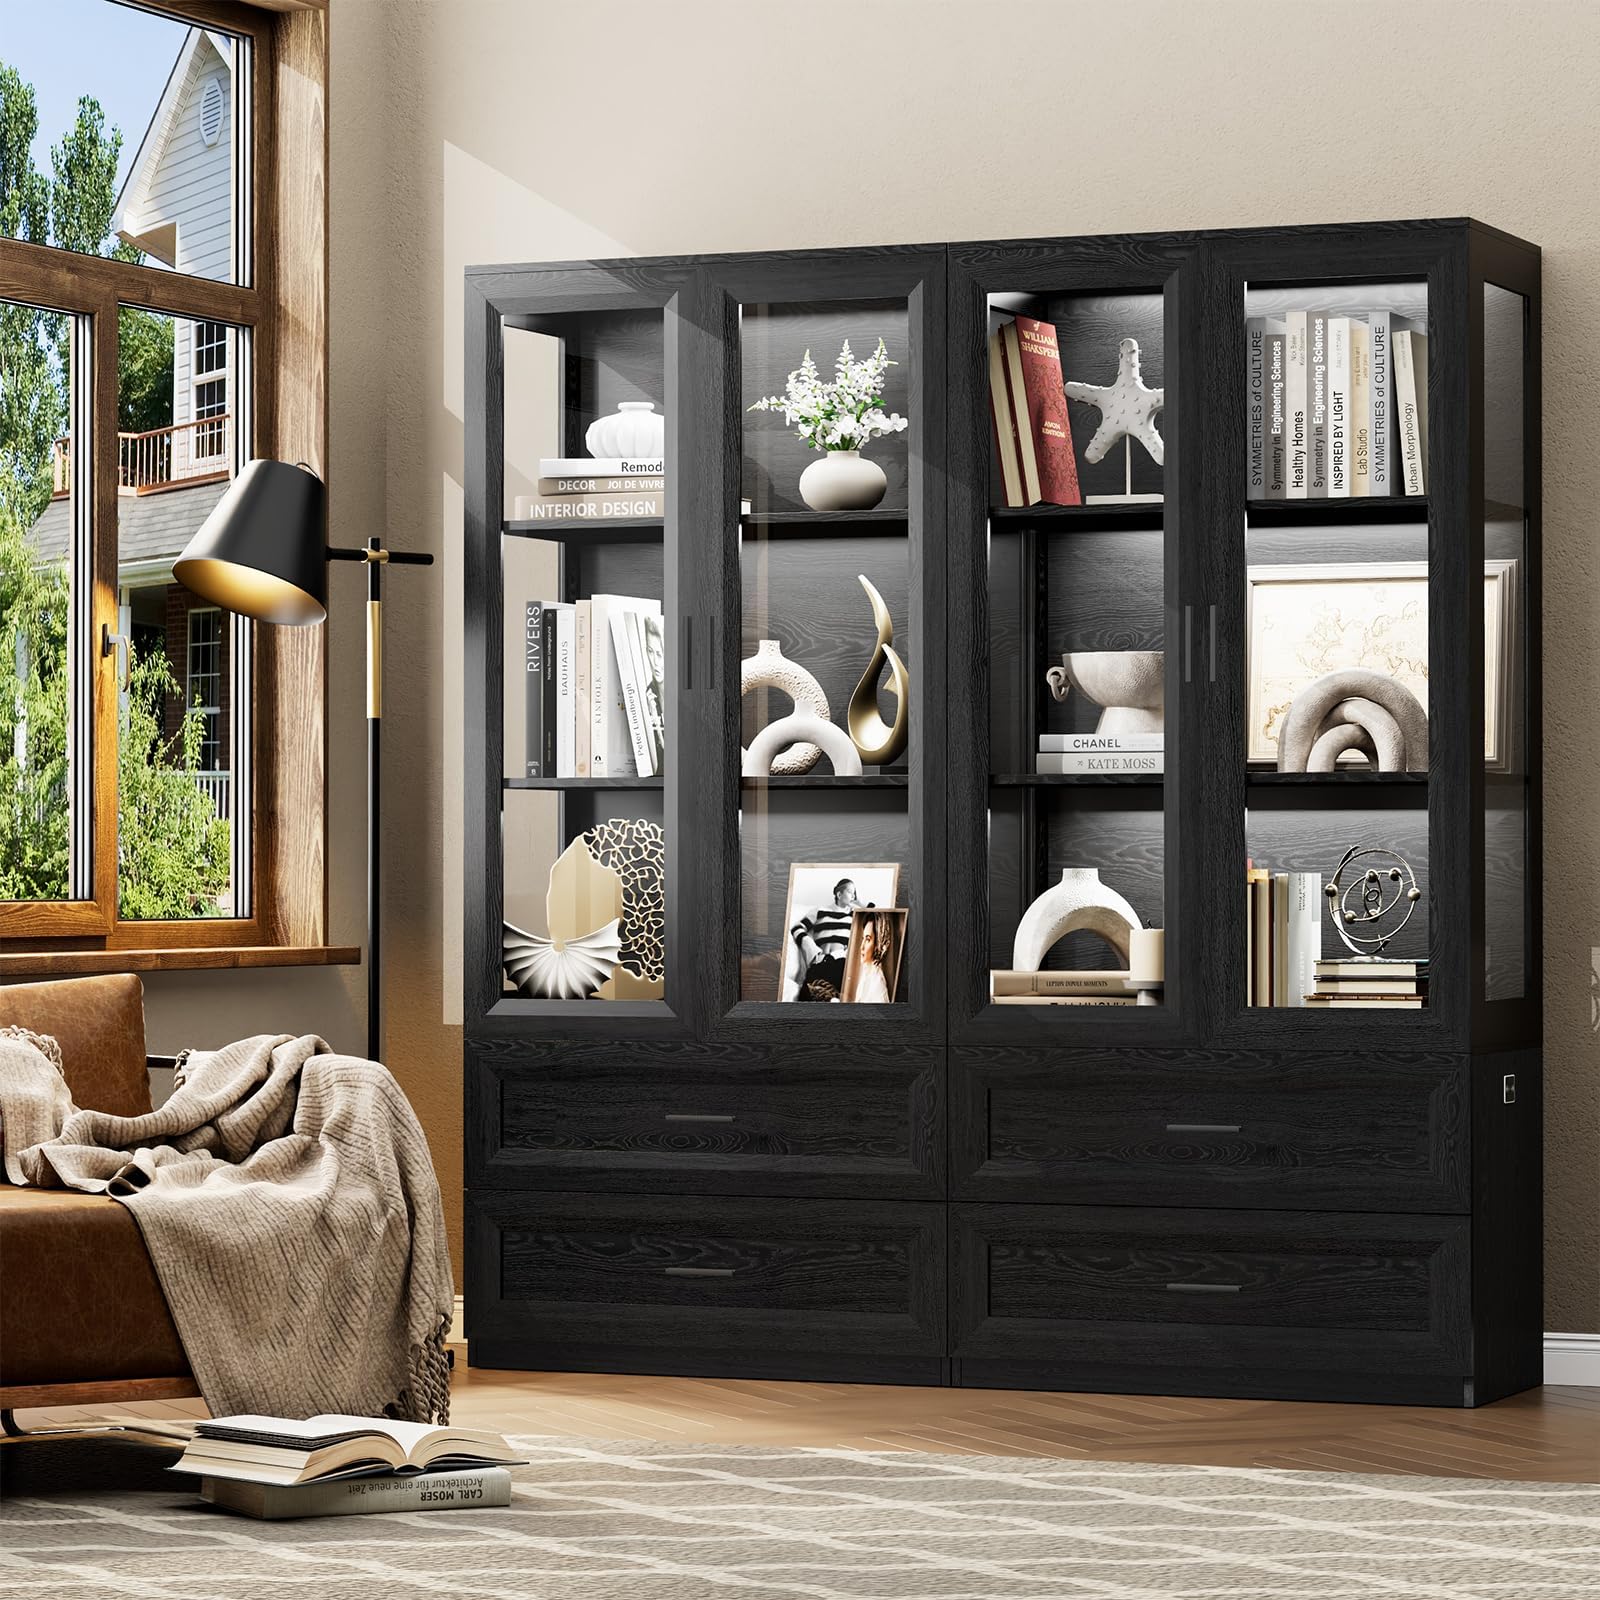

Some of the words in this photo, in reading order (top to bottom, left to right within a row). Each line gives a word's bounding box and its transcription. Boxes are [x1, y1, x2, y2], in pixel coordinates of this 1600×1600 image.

[1032, 321, 1041, 331] of
[1022, 329, 1057, 347] WILLIAM
[1313, 318, 1323, 363] Sciences
[1252, 331, 1262, 388] CULTURE
[1271, 341, 1281, 380] Sciences
[1374, 326, 1385, 383] CULTURE
[1252, 391, 1262, 402] of
[1313, 365, 1326, 424] Engineering
[1374, 386, 1385, 397] of
[1271, 382, 1284, 434] Engineering
[1333, 391, 1343, 422] LIGHT
[1041, 427, 1066, 439] EDITION
[1043, 420, 1061, 430] AVON
[1292, 411, 1304, 446] Homes
[1313, 426, 1323, 436] in
[1333, 424, 1343, 439] BY
[1404, 402, 1416, 460] Morphology
[1252, 404, 1262, 486] SYMMETRIES
[1272, 436, 1281, 446] in
[1356, 428, 1368, 457] Studio
[1374, 400, 1385, 482] SYMMETRIES
[621, 461, 664, 473] Remod
[1271, 447, 1284, 491] Symmetry
[1292, 450, 1307, 488] Healthy
[1313, 439, 1326, 488] Symmetry
[1333, 440, 1343, 489] INSPIRED
[1357, 459, 1368, 476] Lab
[558, 480, 597, 491] DECOR
[607, 480, 622, 490] JOI
[624, 480, 637, 489] DE
[1409, 462, 1419, 494] Urban
[529, 502, 598, 519] INTERIOR
[602, 500, 657, 516] DESIGN
[526, 606, 541, 672] RIVERS
[624, 682, 640, 731] Lindbergh
[635, 732, 645, 757] Peter
[1073, 739, 1121, 749] CHANEL
[1087, 758, 1120, 769] KATE
[1122, 758, 1156, 769] MOSS
[348, 1485, 366, 1495] Zeit
[369, 1483, 391, 1491] neue
[394, 1482, 413, 1492] eine
[416, 1481, 429, 1491] für
[432, 1478, 483, 1489] Architektur
[420, 1491, 454, 1501] MOSER
[458, 1489, 483, 1499] CARL
